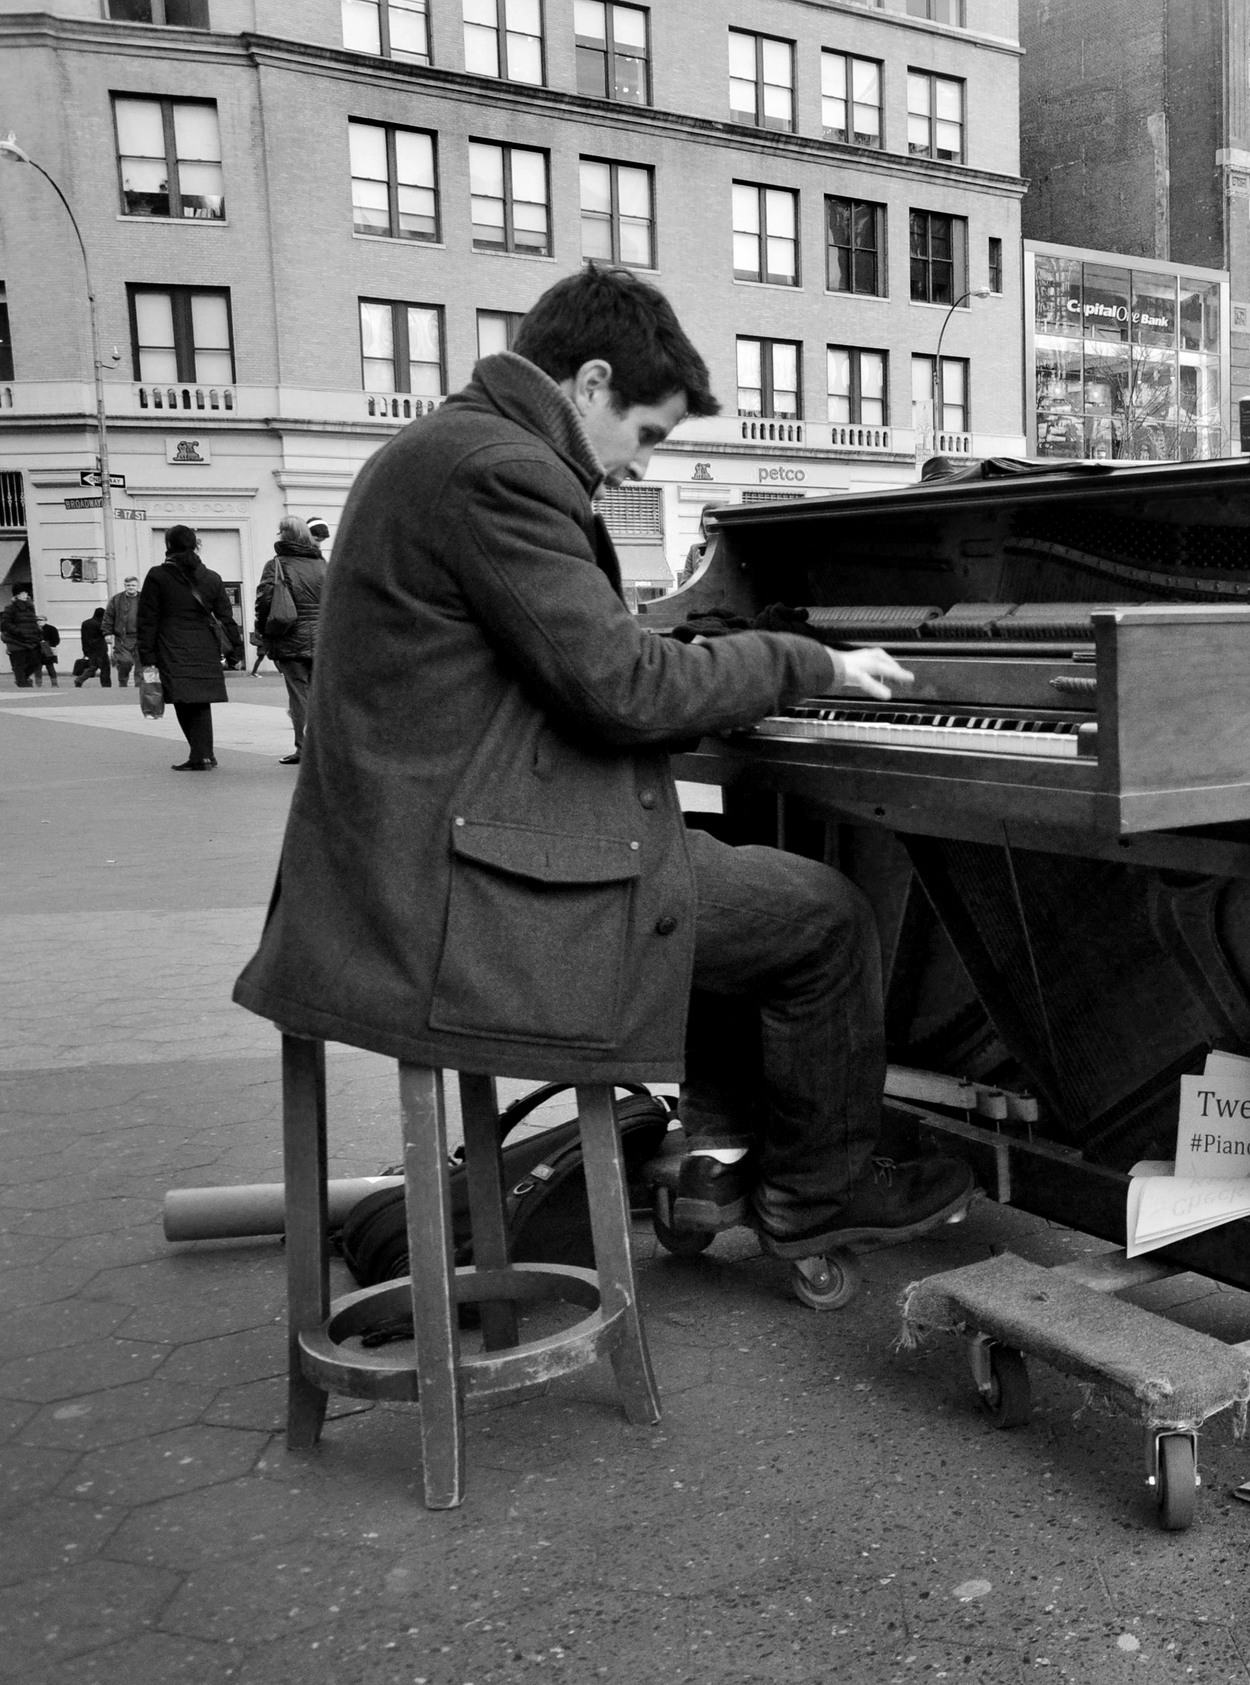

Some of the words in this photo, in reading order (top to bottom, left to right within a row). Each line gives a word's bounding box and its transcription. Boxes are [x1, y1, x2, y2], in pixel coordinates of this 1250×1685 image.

[1066, 299, 1117, 318] Capital
[1141, 313, 1169, 327] Bank
[758, 466, 805, 482] petco
[65, 499, 102, 509] BROADWAY
[115, 509, 121, 519] E
[123, 510, 133, 519] 17
[134, 511, 146, 520] ST
